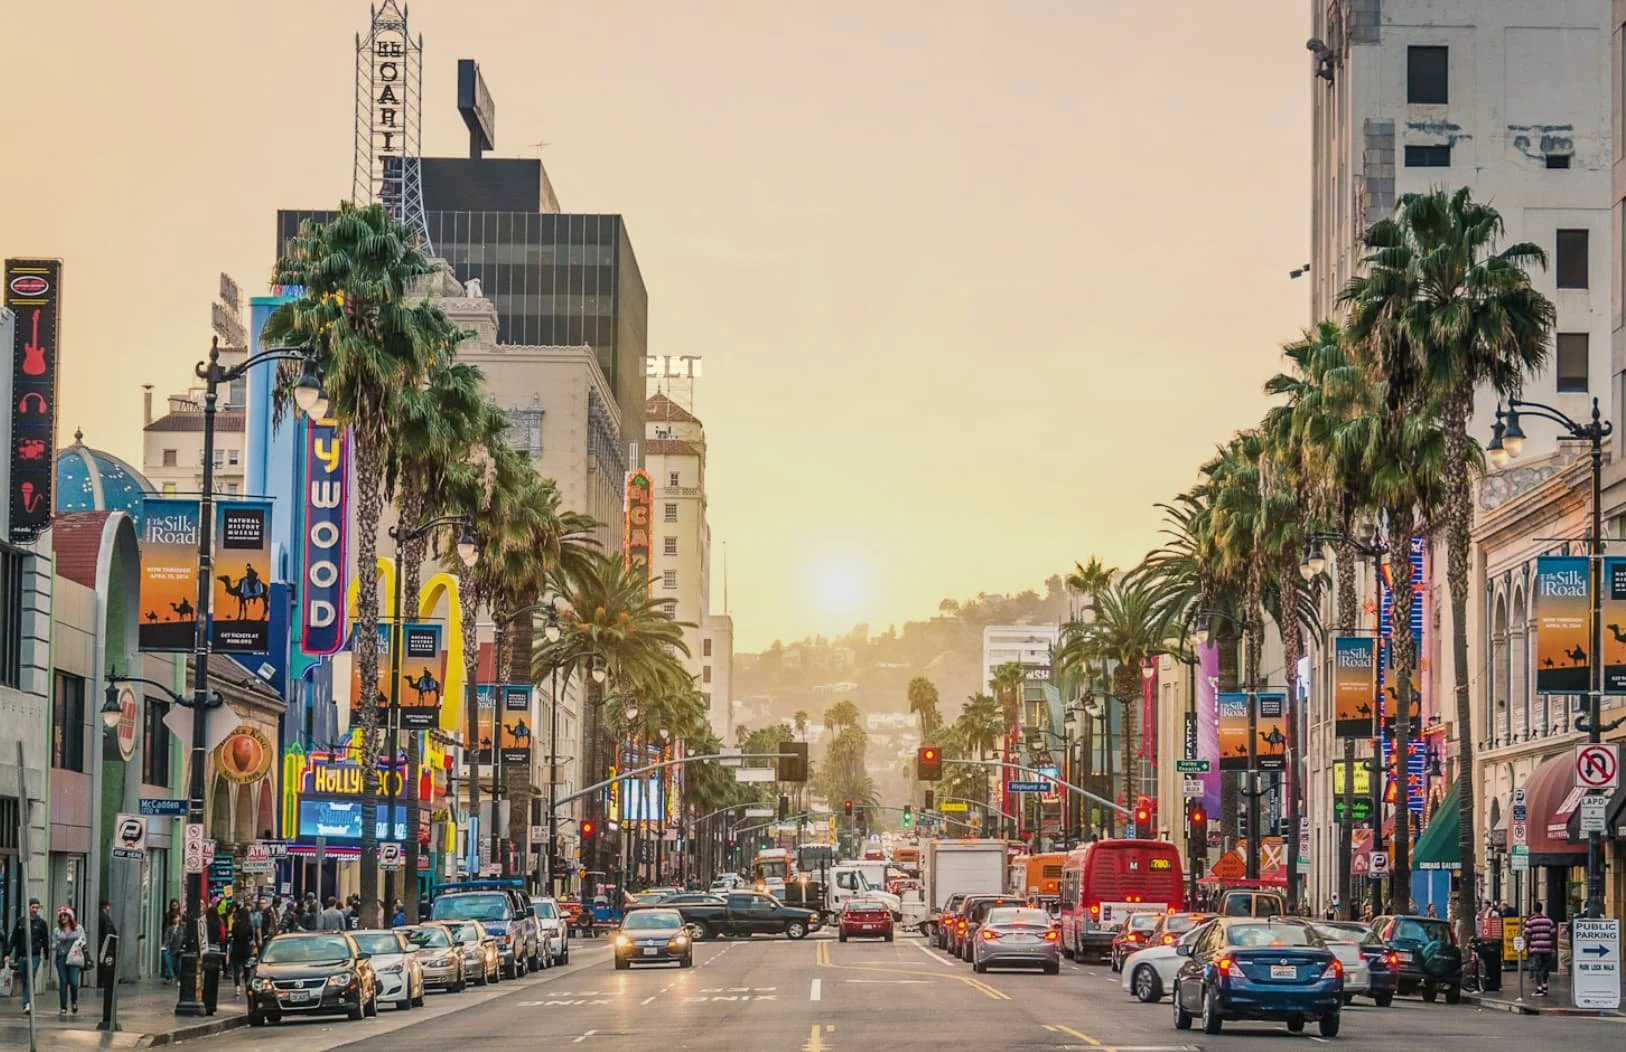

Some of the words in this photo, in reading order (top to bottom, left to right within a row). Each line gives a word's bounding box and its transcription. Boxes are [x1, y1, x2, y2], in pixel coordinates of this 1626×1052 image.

[164, 515, 192, 531] Silk
[151, 526, 196, 545] Road
[1556, 570, 1582, 586] Silk
[1546, 580, 1586, 596] Road
[1350, 648, 1368, 659] Silk
[1342, 656, 1372, 668] Road
[1224, 707, 1247, 716] Road
[141, 800, 180, 809] McCadden
[250, 848, 266, 856] ATM
[1151, 859, 1168, 868] 780
